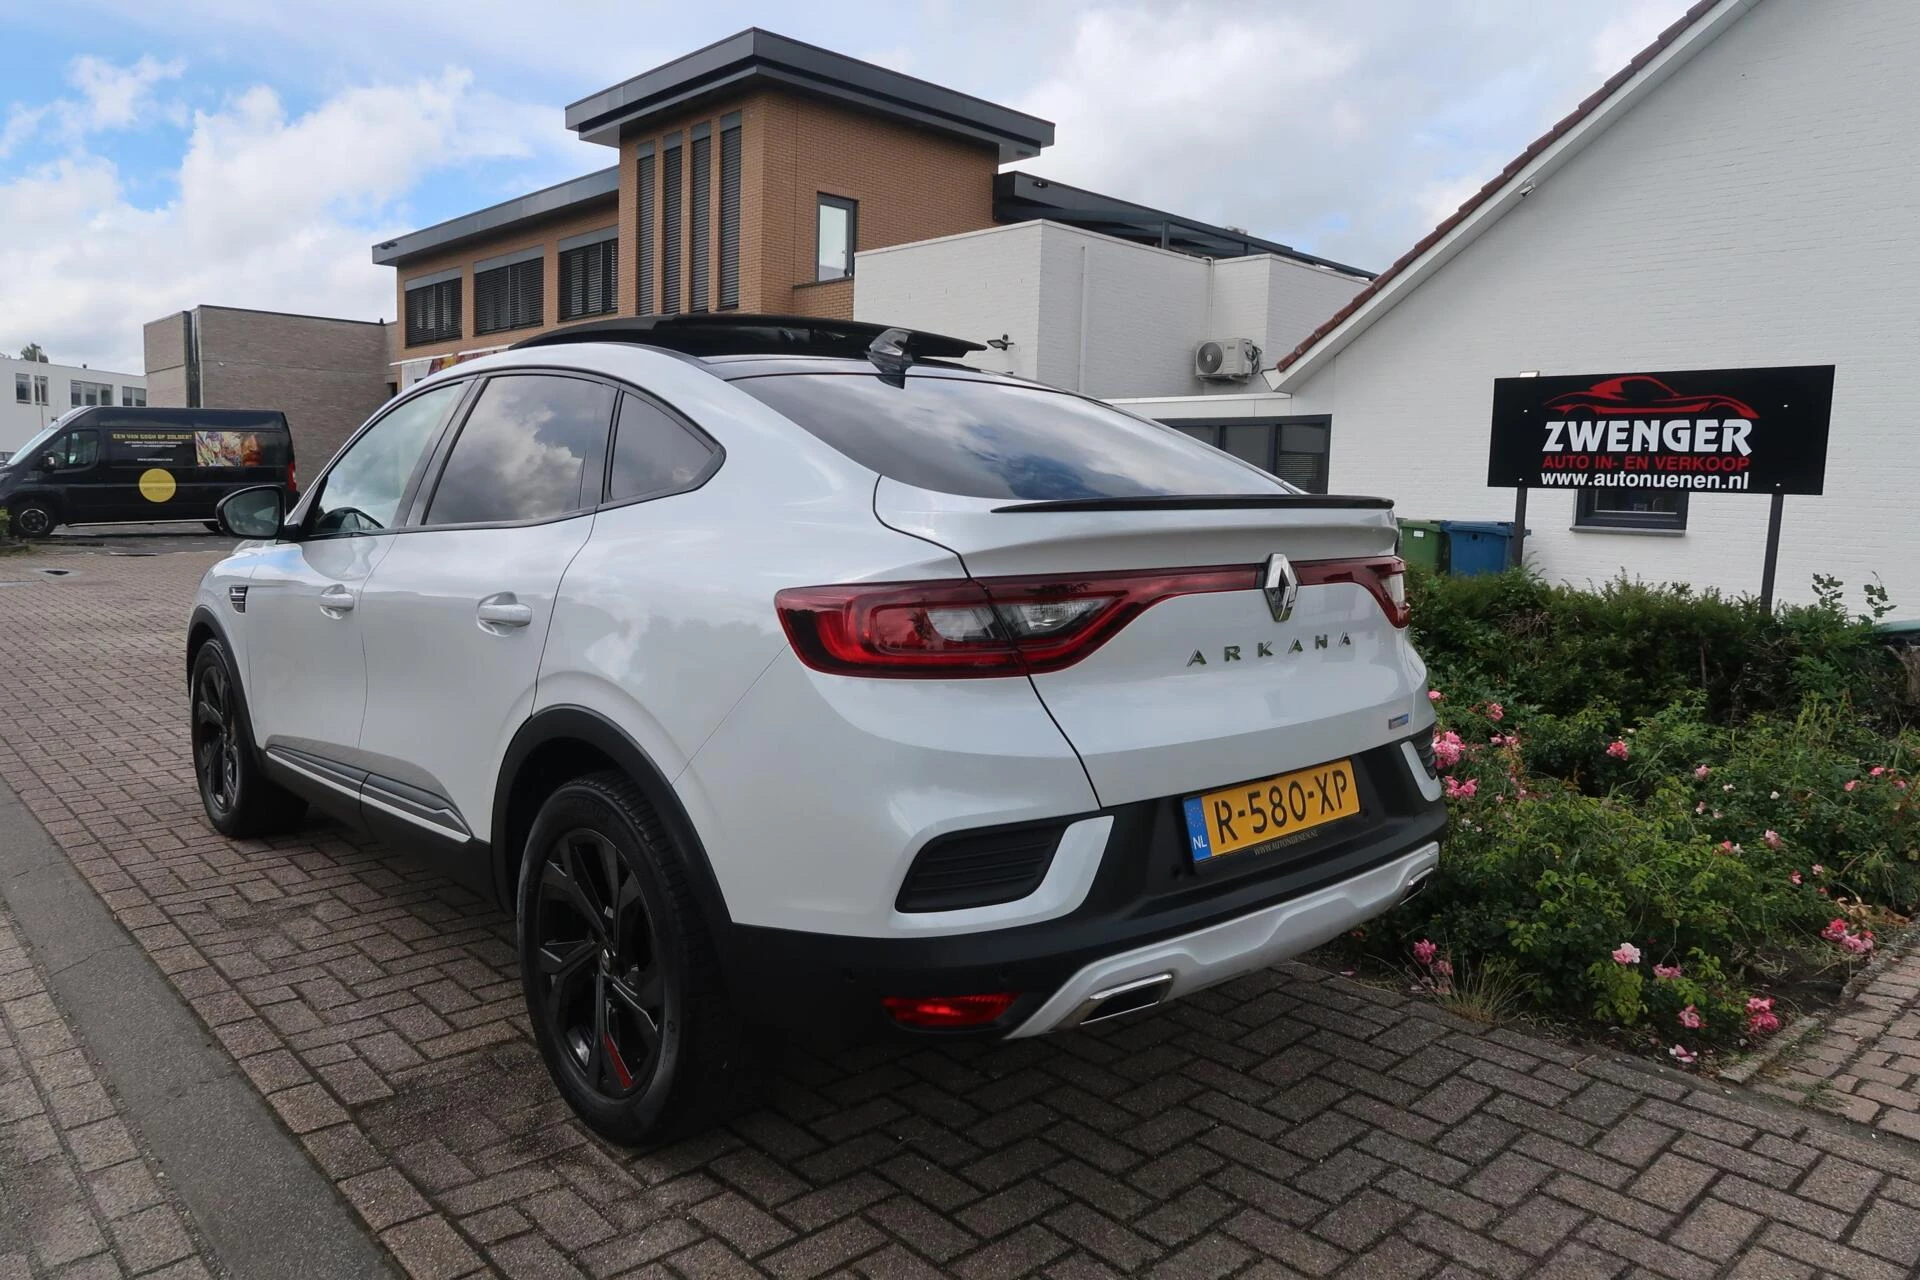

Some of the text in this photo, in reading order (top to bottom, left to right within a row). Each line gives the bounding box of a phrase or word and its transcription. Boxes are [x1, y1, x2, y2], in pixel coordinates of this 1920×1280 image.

[1542, 419, 1752, 456] ZWENGER
[1542, 455, 1750, 472] AUTO IN- EN VERKOOP
[1541, 471, 1749, 489] www.autonuenen.nl
[1186, 631, 1352, 667] ARKANA
[1213, 769, 1348, 844] R-580-XP
[1192, 834, 1208, 850] NL
